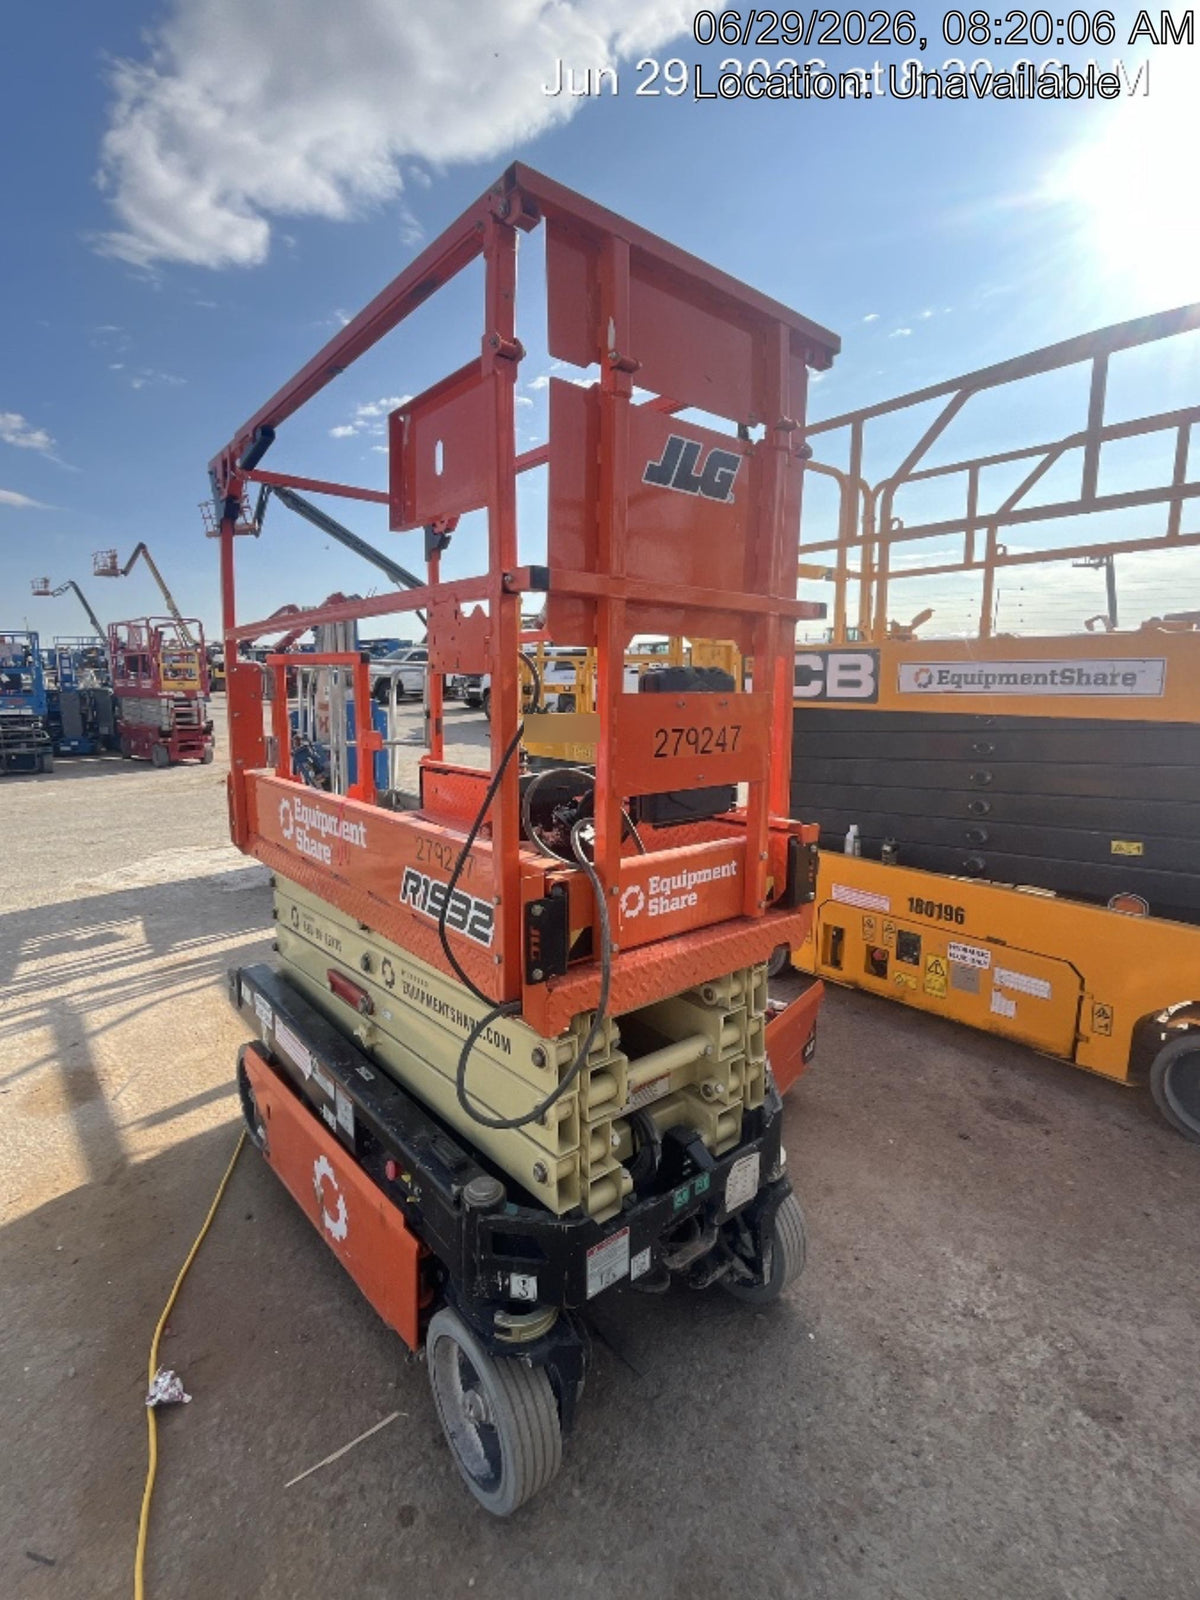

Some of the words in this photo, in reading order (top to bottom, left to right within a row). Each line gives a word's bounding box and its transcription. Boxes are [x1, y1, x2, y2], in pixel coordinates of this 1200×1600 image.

[642, 433, 743, 504] JLG
[937, 667, 1138, 689] EquipmentShare
[654, 724, 742, 758] 279247
[293, 796, 366, 849] Equipment
[296, 827, 332, 865] Share
[416, 836, 477, 879] 27927
[648, 860, 738, 896] Equipment
[400, 866, 495, 948] R1932
[648, 891, 698, 917] Share
[907, 896, 965, 926] 180196
[401, 980, 512, 1056] EQUIPMENTSHAR.COM
